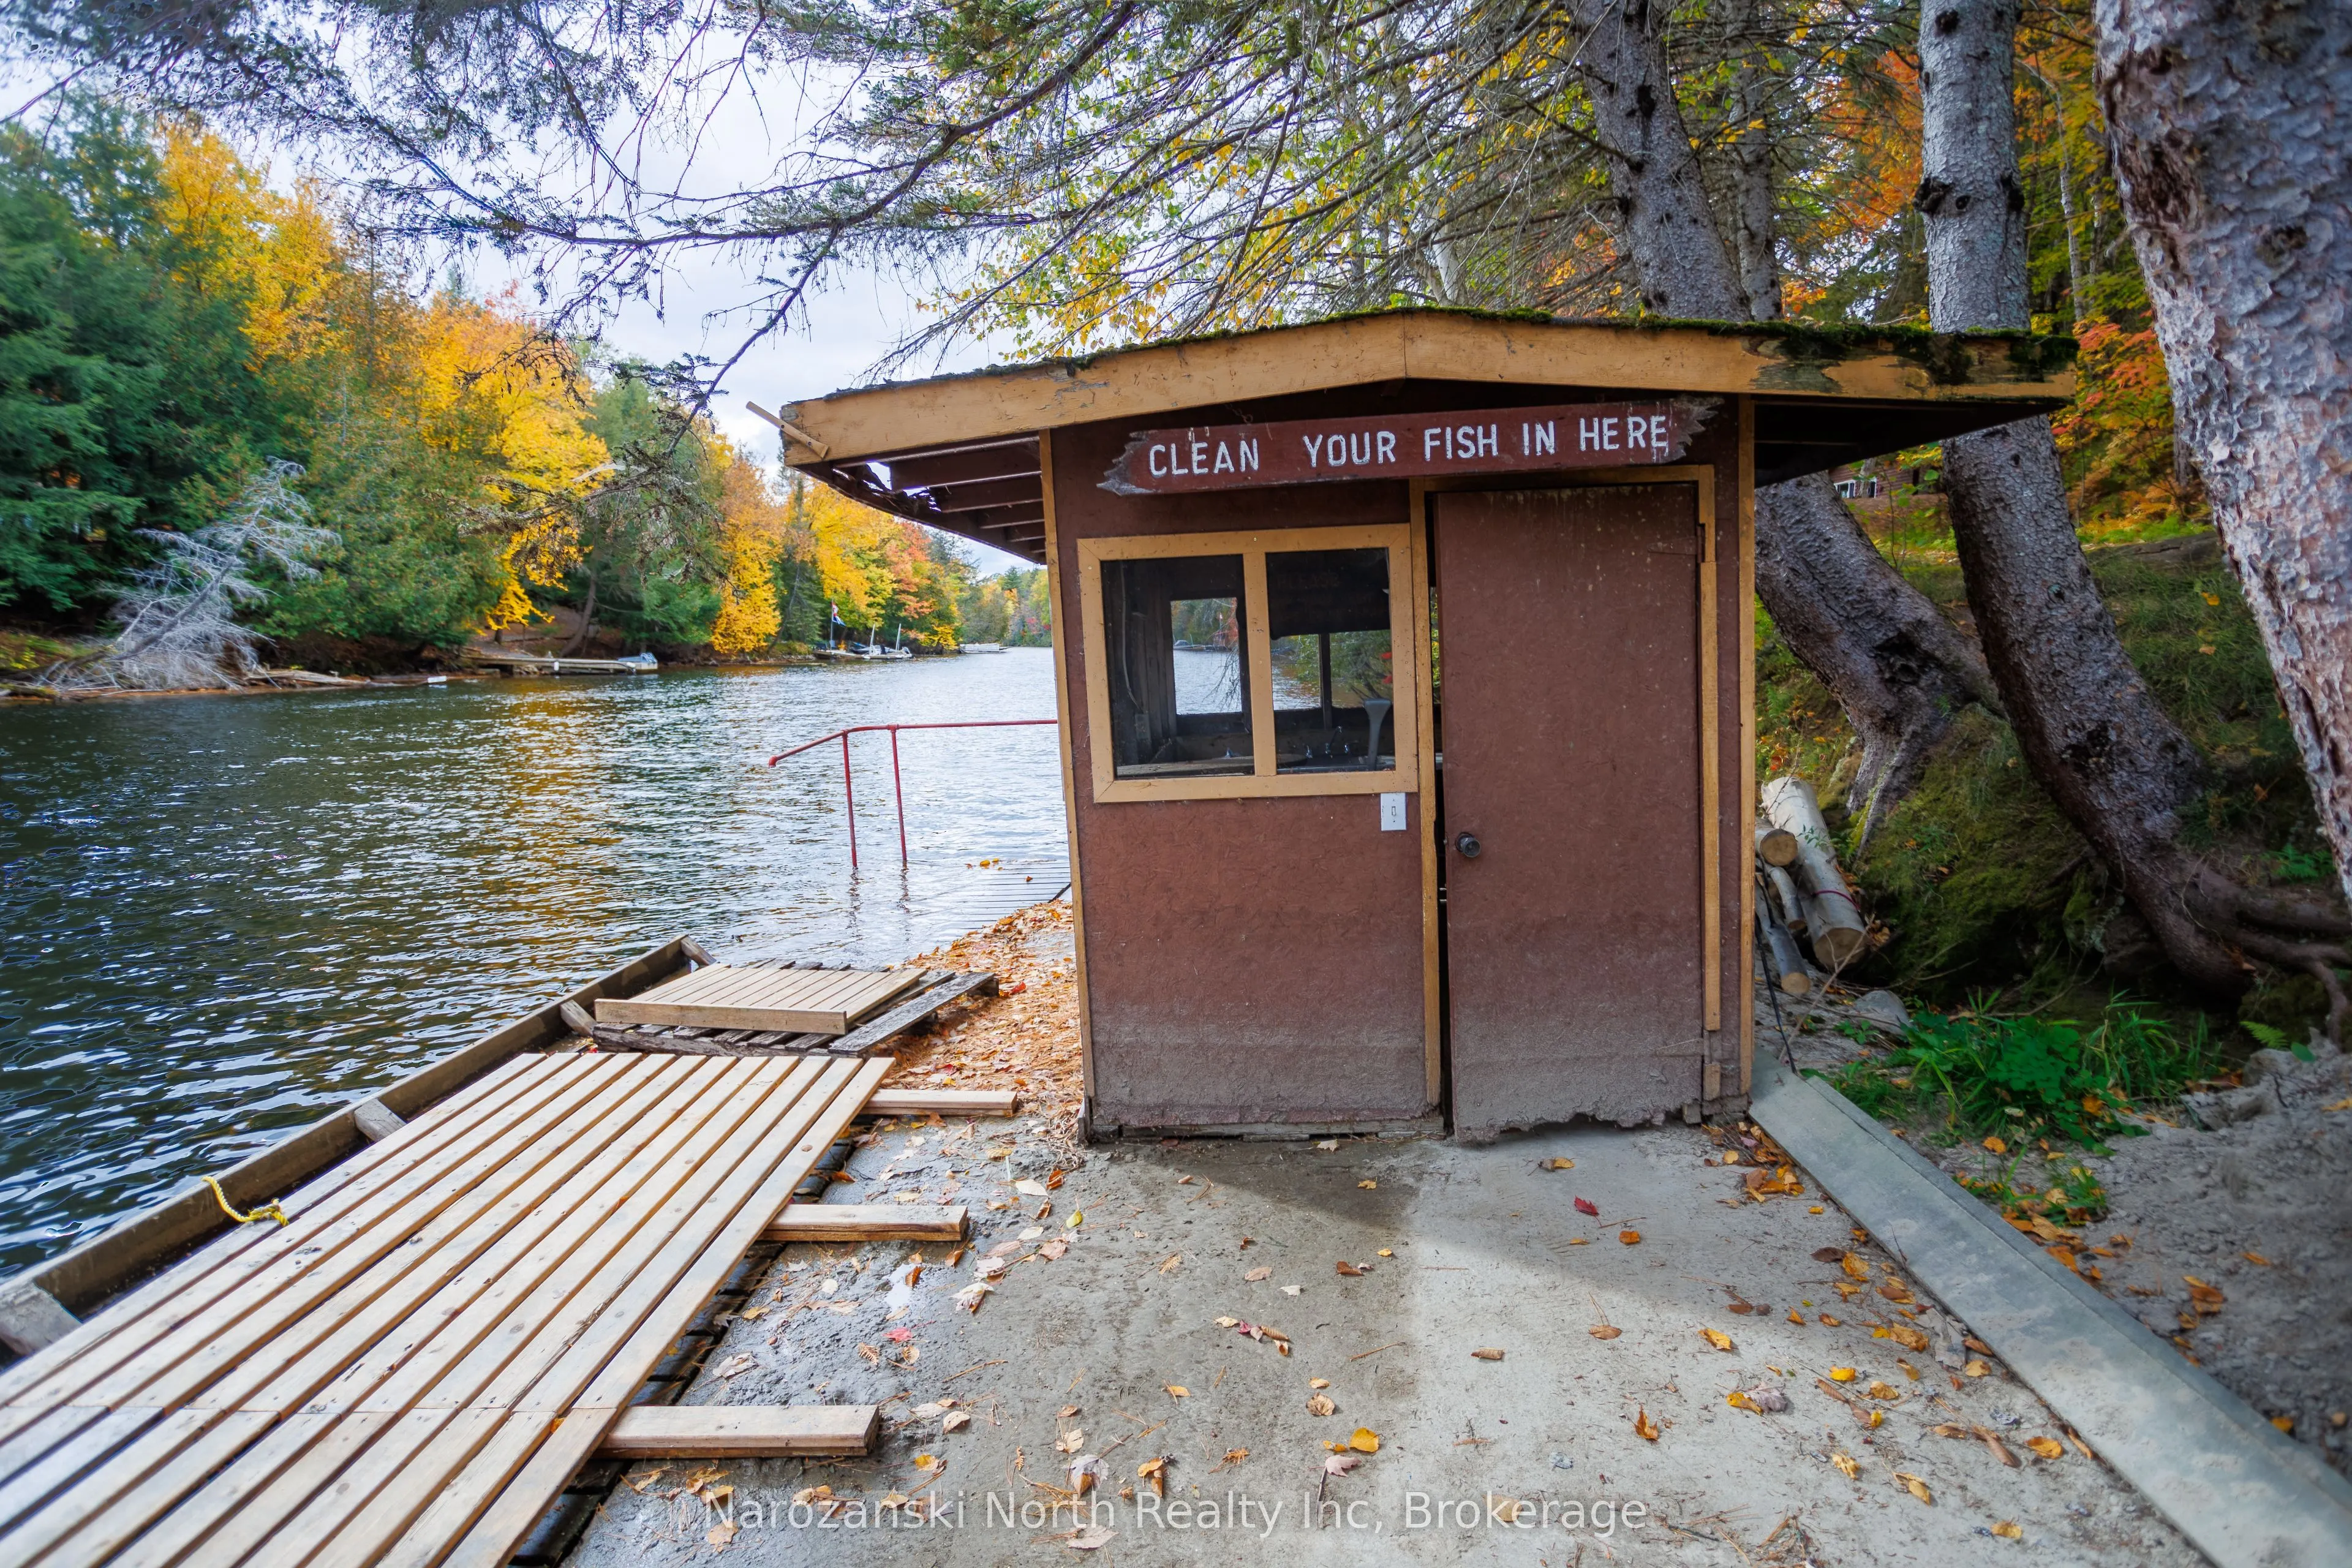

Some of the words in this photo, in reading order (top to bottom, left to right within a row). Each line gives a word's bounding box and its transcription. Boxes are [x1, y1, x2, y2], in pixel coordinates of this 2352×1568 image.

[1148, 437, 1259, 478] CLEAN
[1301, 430, 1397, 468] YOUR
[1423, 423, 1499, 462] FISH
[1521, 420, 1556, 457] IN
[1579, 415, 1669, 453] HERE
